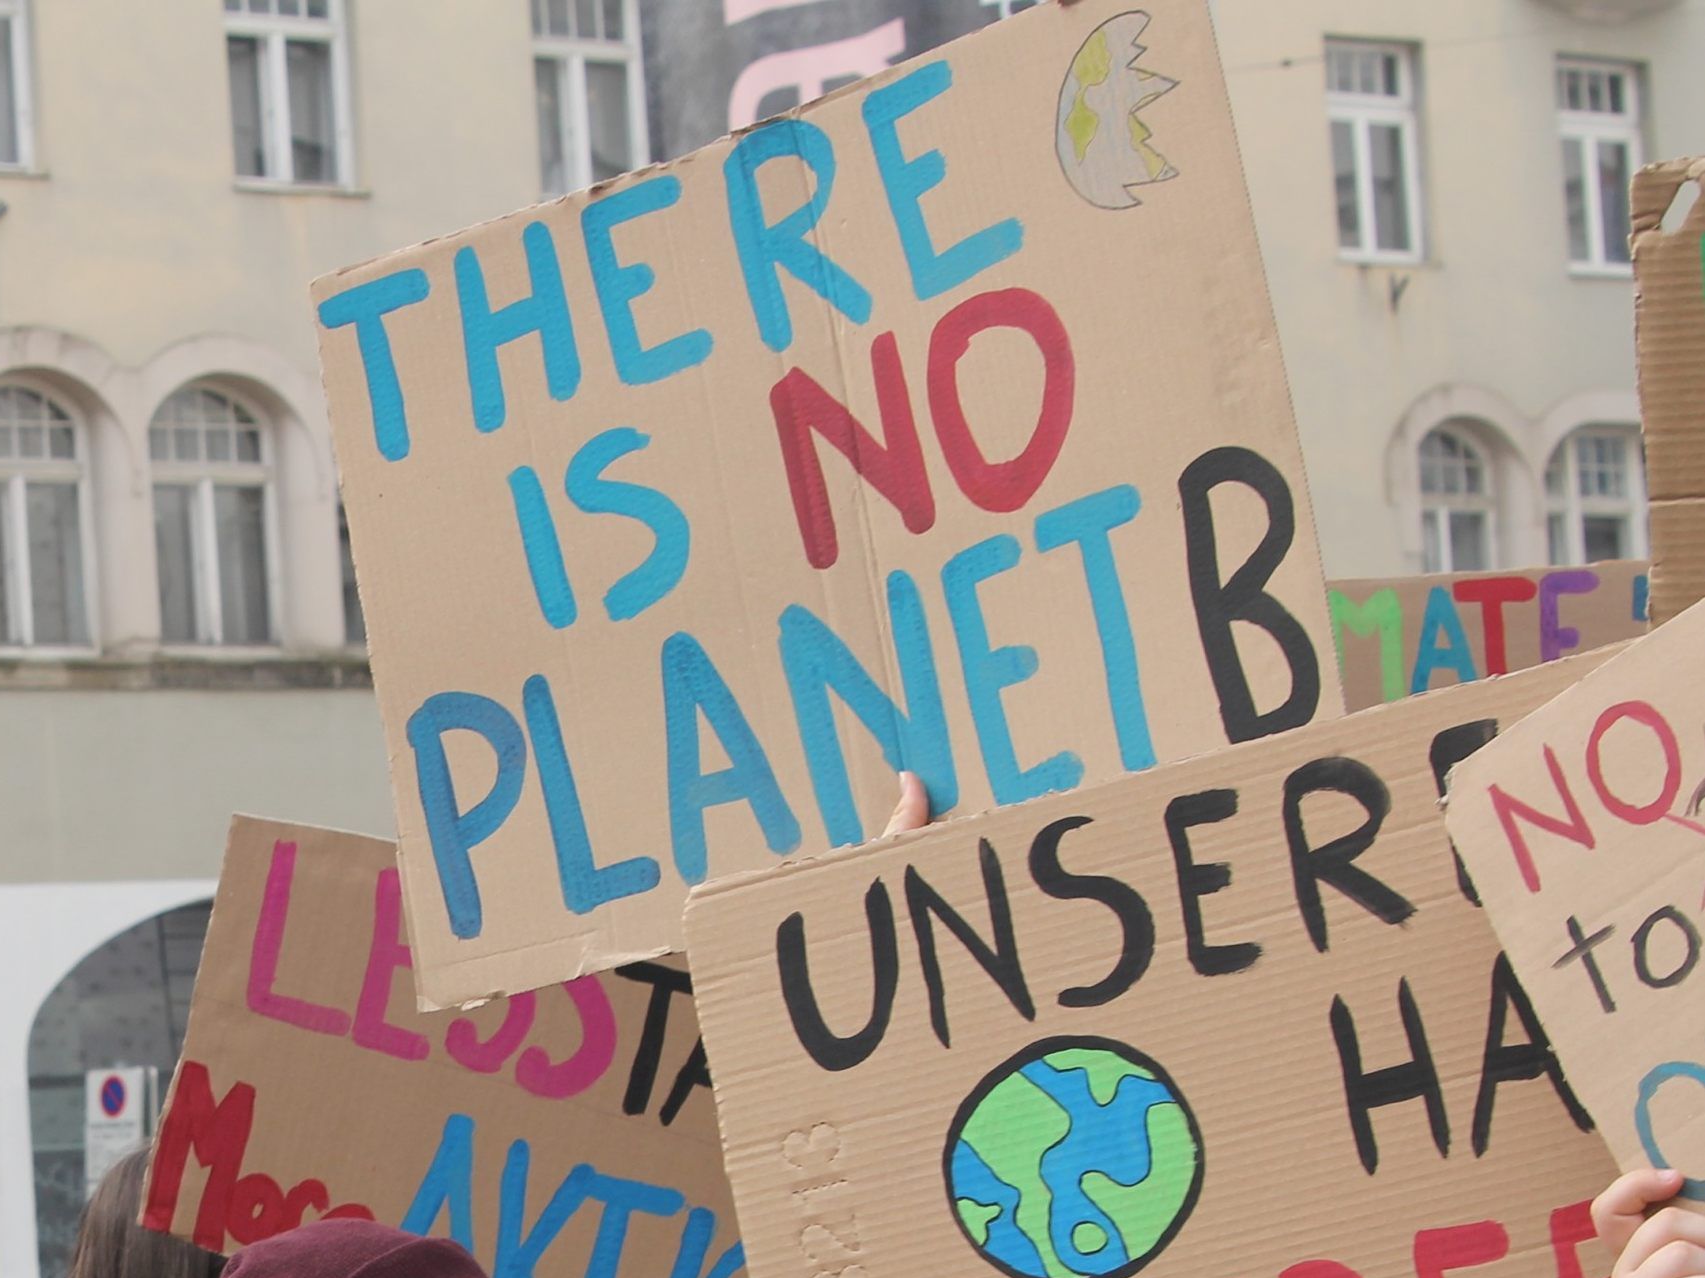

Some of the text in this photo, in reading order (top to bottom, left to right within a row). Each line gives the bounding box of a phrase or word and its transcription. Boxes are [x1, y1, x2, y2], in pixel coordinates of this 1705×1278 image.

[318, 60, 1024, 461] THERE
[506, 286, 1075, 629] IS NO
[407, 445, 1321, 939] PLANET B
[142, 1060, 376, 1251] Mor
